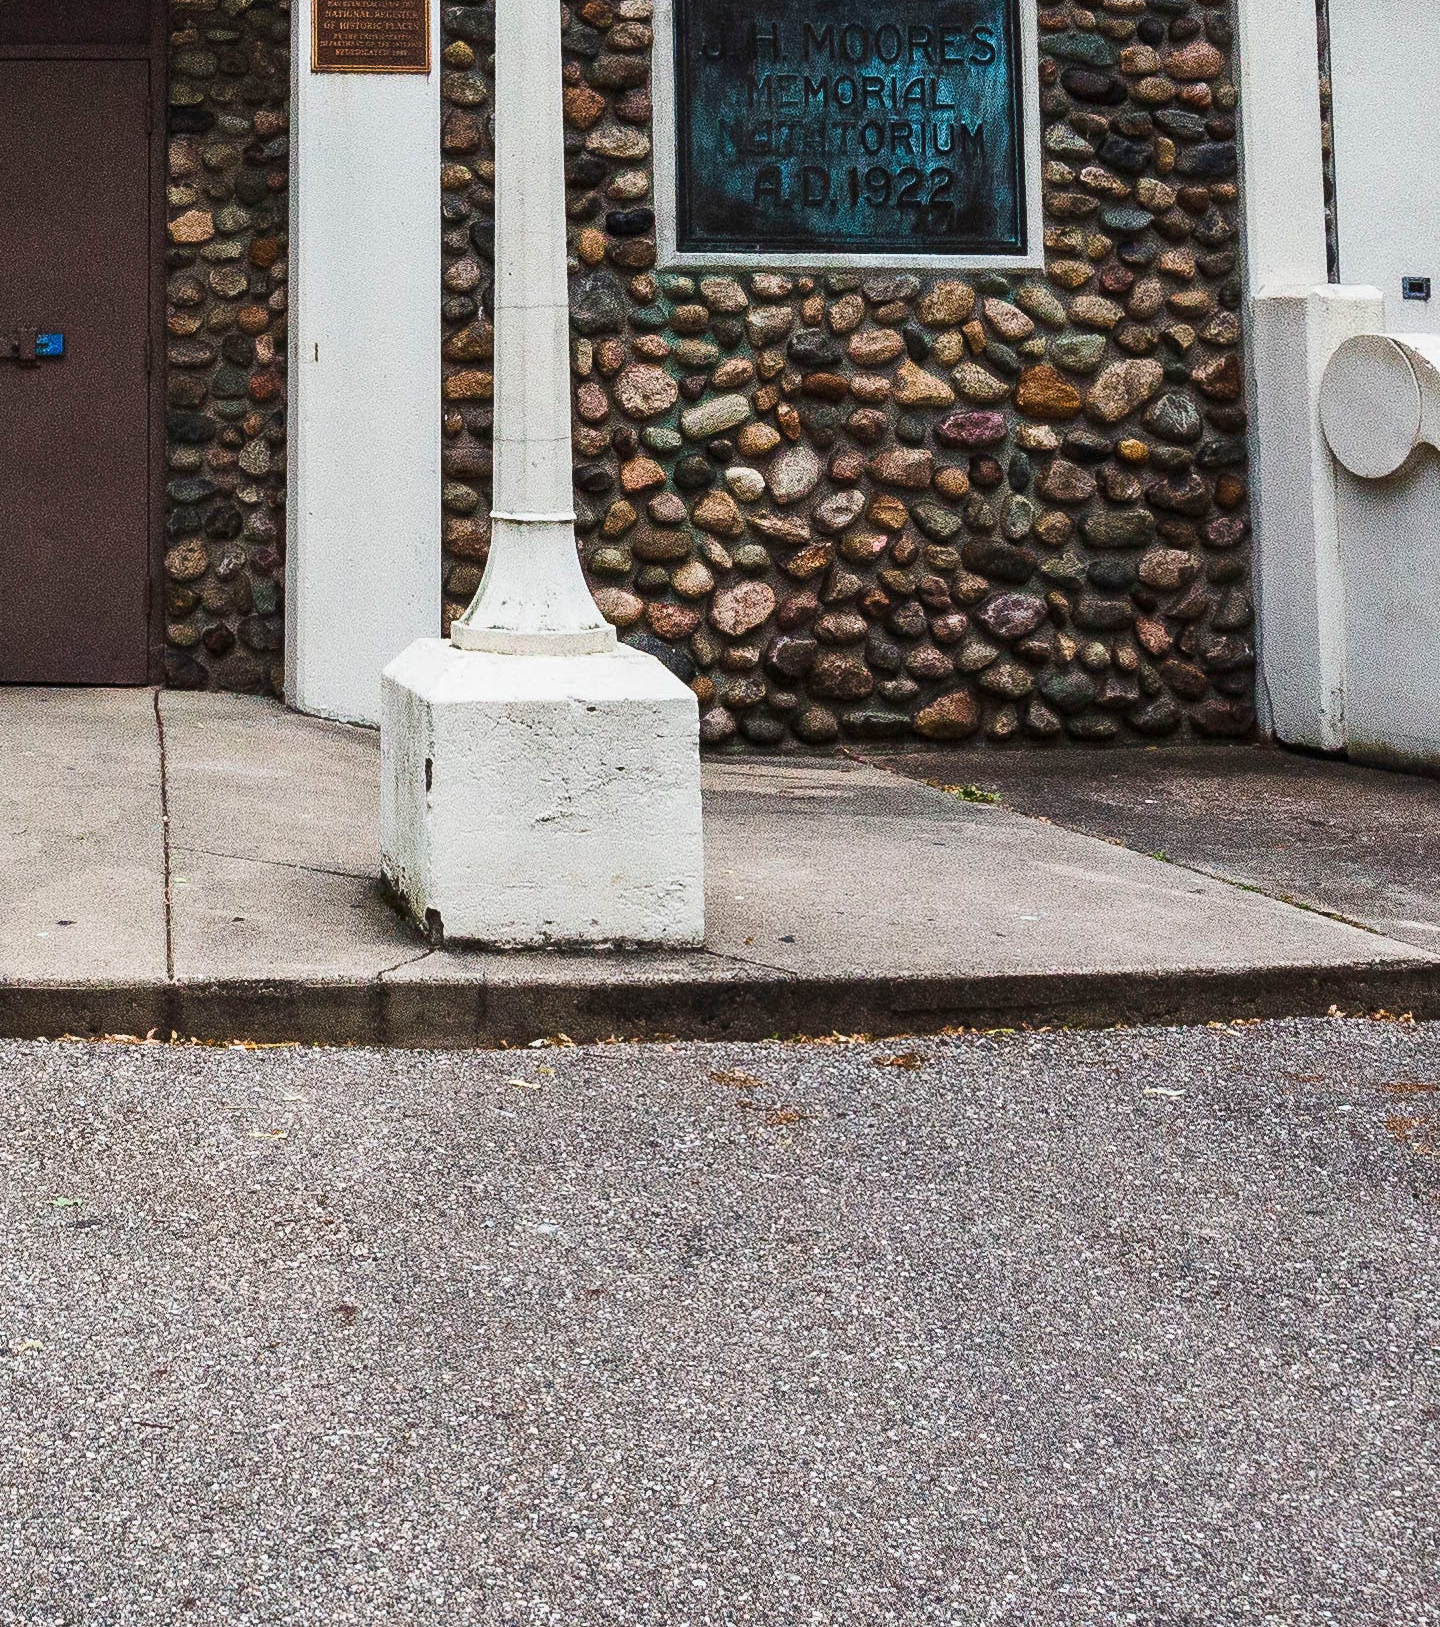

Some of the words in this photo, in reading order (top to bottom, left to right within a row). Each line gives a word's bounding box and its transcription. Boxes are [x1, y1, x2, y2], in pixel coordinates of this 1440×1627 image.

[803, 22, 997, 66] MOORES
[748, 74, 955, 111] MEMORIAL
[719, 119, 985, 156] NATATORIUM
